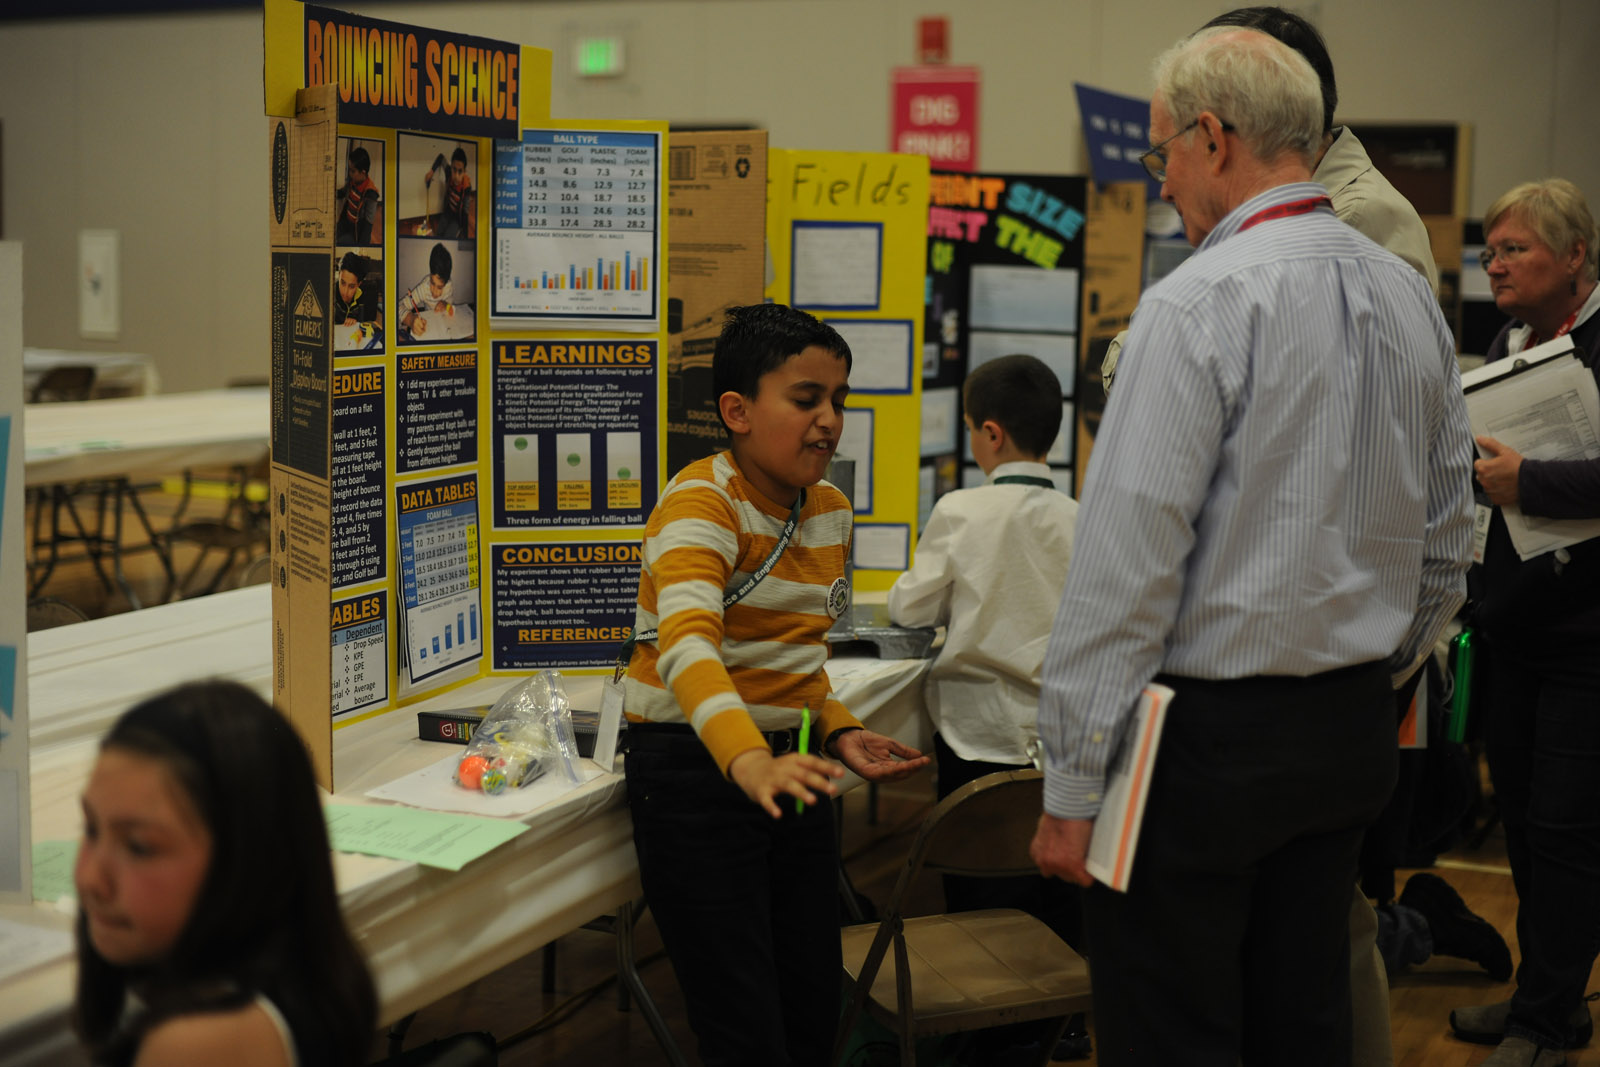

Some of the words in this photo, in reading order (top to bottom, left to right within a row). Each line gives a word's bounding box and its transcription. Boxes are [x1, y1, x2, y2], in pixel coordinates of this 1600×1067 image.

[309, 19, 418, 109] BOUNCING
[425, 40, 518, 120] SCIENCE
[554, 135, 576, 144] BALL
[577, 136, 599, 144] TYPE
[526, 156, 551, 164] (inches)
[529, 180, 547, 188] 14.8
[563, 181, 577, 189] 8.6
[792, 163, 910, 206] Fields
[628, 195, 646, 203] 18.5
[528, 206, 546, 214] 27.1
[593, 207, 612, 215] 24.6
[1005, 182, 1085, 241] SIZE
[593, 220, 612, 228] 28.3
[995, 213, 1064, 270] THE
[295, 319, 322, 339] ELMER'S
[293, 349, 312, 368] Tri-Fold
[499, 345, 652, 364] LEARNINGS
[401, 356, 435, 370] SAFETY
[437, 353, 476, 368] MEASURE
[311, 373, 327, 392] Board
[581, 384, 605, 392] Energy:
[363, 403, 373, 412] flat
[334, 430, 346, 440] wall
[347, 429, 353, 438] at
[355, 429, 358, 437] 1
[359, 427, 372, 437] feet,
[373, 426, 377, 435] 2
[335, 442, 349, 451] feet,
[350, 439, 361, 449] and
[362, 439, 365, 448] 5
[366, 438, 378, 447] feet
[363, 451, 375, 460] tape
[340, 466, 346, 474] at
[347, 465, 351, 473] 1
[352, 463, 363, 472] feet
[364, 461, 382, 472] height
[338, 478, 347, 487] the
[349, 474, 367, 485] board.
[333, 490, 352, 500] height
[353, 487, 359, 496] of
[360, 485, 380, 494] bounce
[402, 489, 433, 510] DATA
[435, 481, 476, 503] TABLES
[340, 501, 359, 512] record
[360, 499, 369, 508] the
[370, 498, 383, 507] data
[337, 514, 348, 525] and
[349, 513, 355, 524] 4,
[355, 512, 366, 521] five
[367, 510, 382, 519] times
[601, 515, 626, 524] falling
[337, 561, 360, 571] through
[361, 558, 365, 566] 6
[366, 555, 380, 565] using
[739, 579, 756, 596] and
[754, 537, 789, 581] Engineering
[785, 520, 795, 536] Fair
[342, 572, 353, 581] and
[354, 568, 367, 579] Golf
[367, 566, 378, 576] ball
[497, 569, 508, 577] My
[510, 569, 548, 577] experiment
[497, 599, 517, 607] graph
[498, 619, 533, 627] hypothesis
[346, 623, 383, 640] Dependent
[518, 627, 632, 641] REFERENCES
[354, 640, 366, 650] Drop
[368, 635, 384, 648] Speed
[354, 651, 364, 661] KPE
[354, 662, 364, 672] GPE
[354, 673, 364, 683] EPE
[354, 681, 376, 694] Average
[354, 693, 374, 704] bounce
